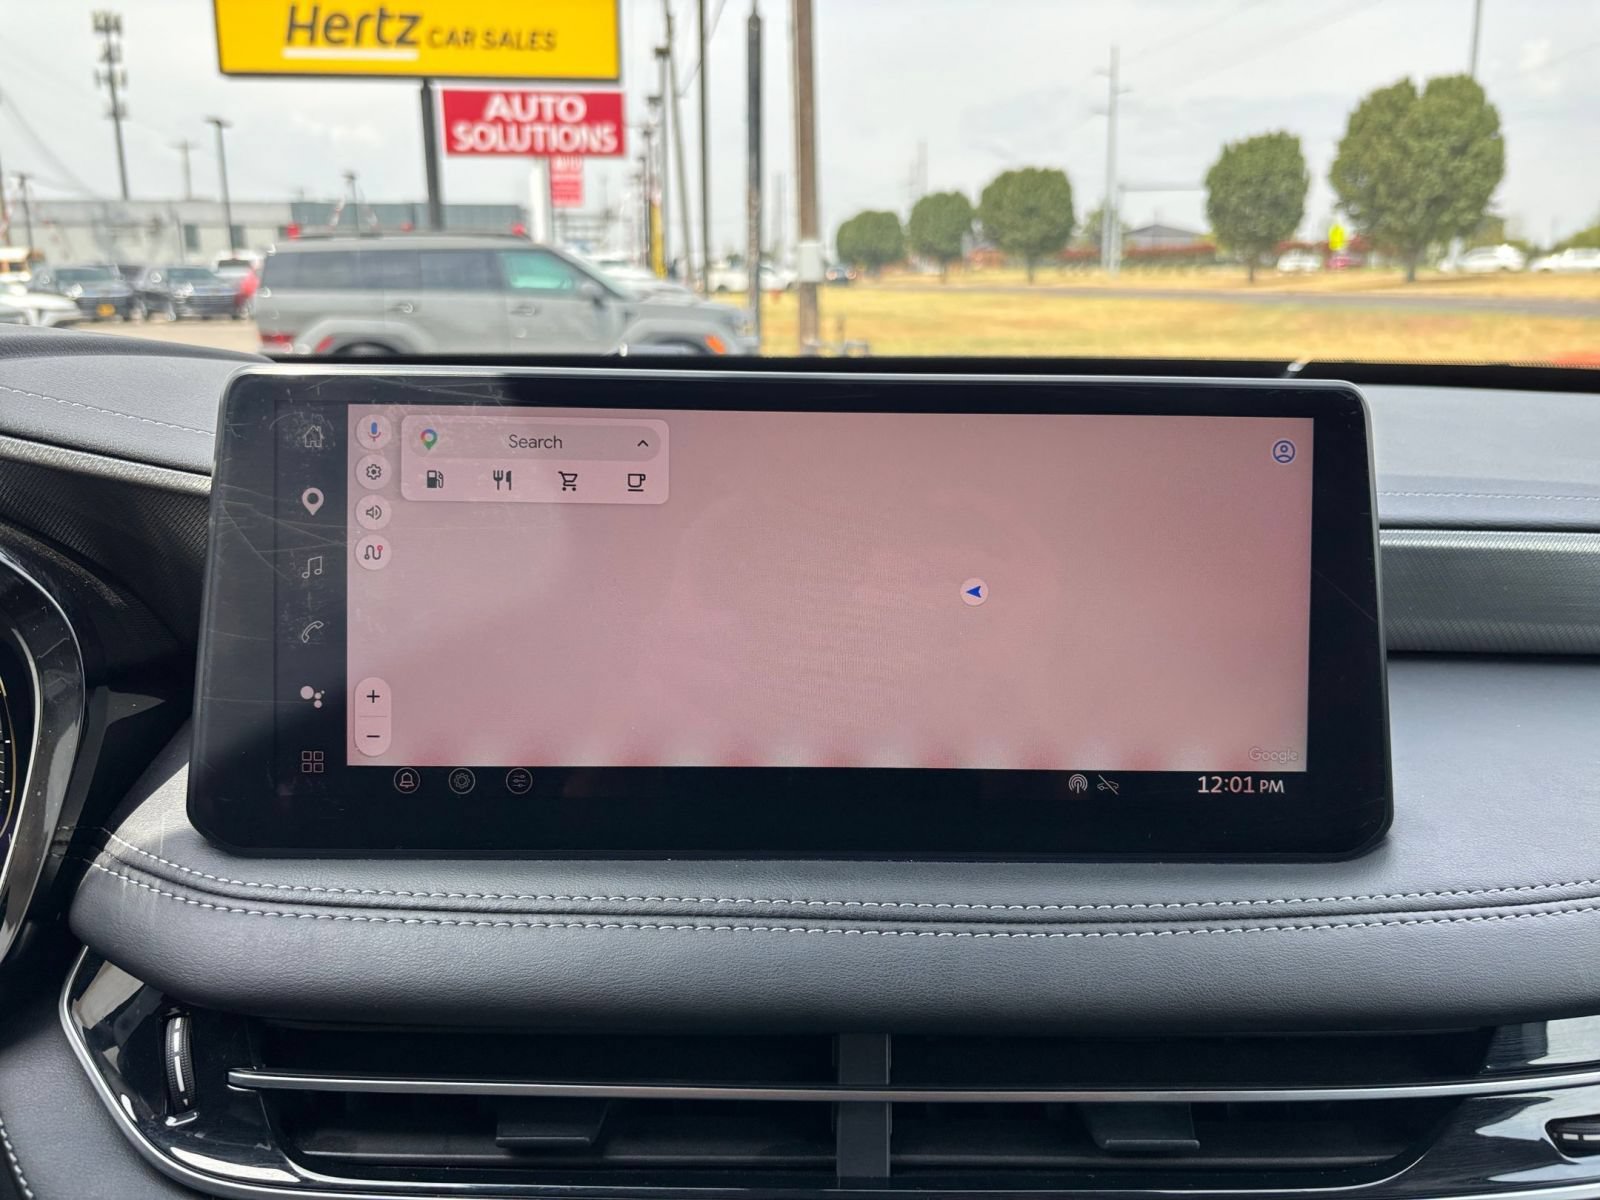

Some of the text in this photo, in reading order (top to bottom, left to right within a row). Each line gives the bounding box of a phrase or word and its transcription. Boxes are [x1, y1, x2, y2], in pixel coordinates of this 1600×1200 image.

[286, 4, 557, 51] Hertz CAR SALES
[485, 95, 586, 122] AUTO
[452, 122, 618, 153] SOLUTIONS
[508, 434, 563, 449] Search
[1249, 747, 1298, 763] Google
[1197, 776, 1285, 793] 12:01 PM
